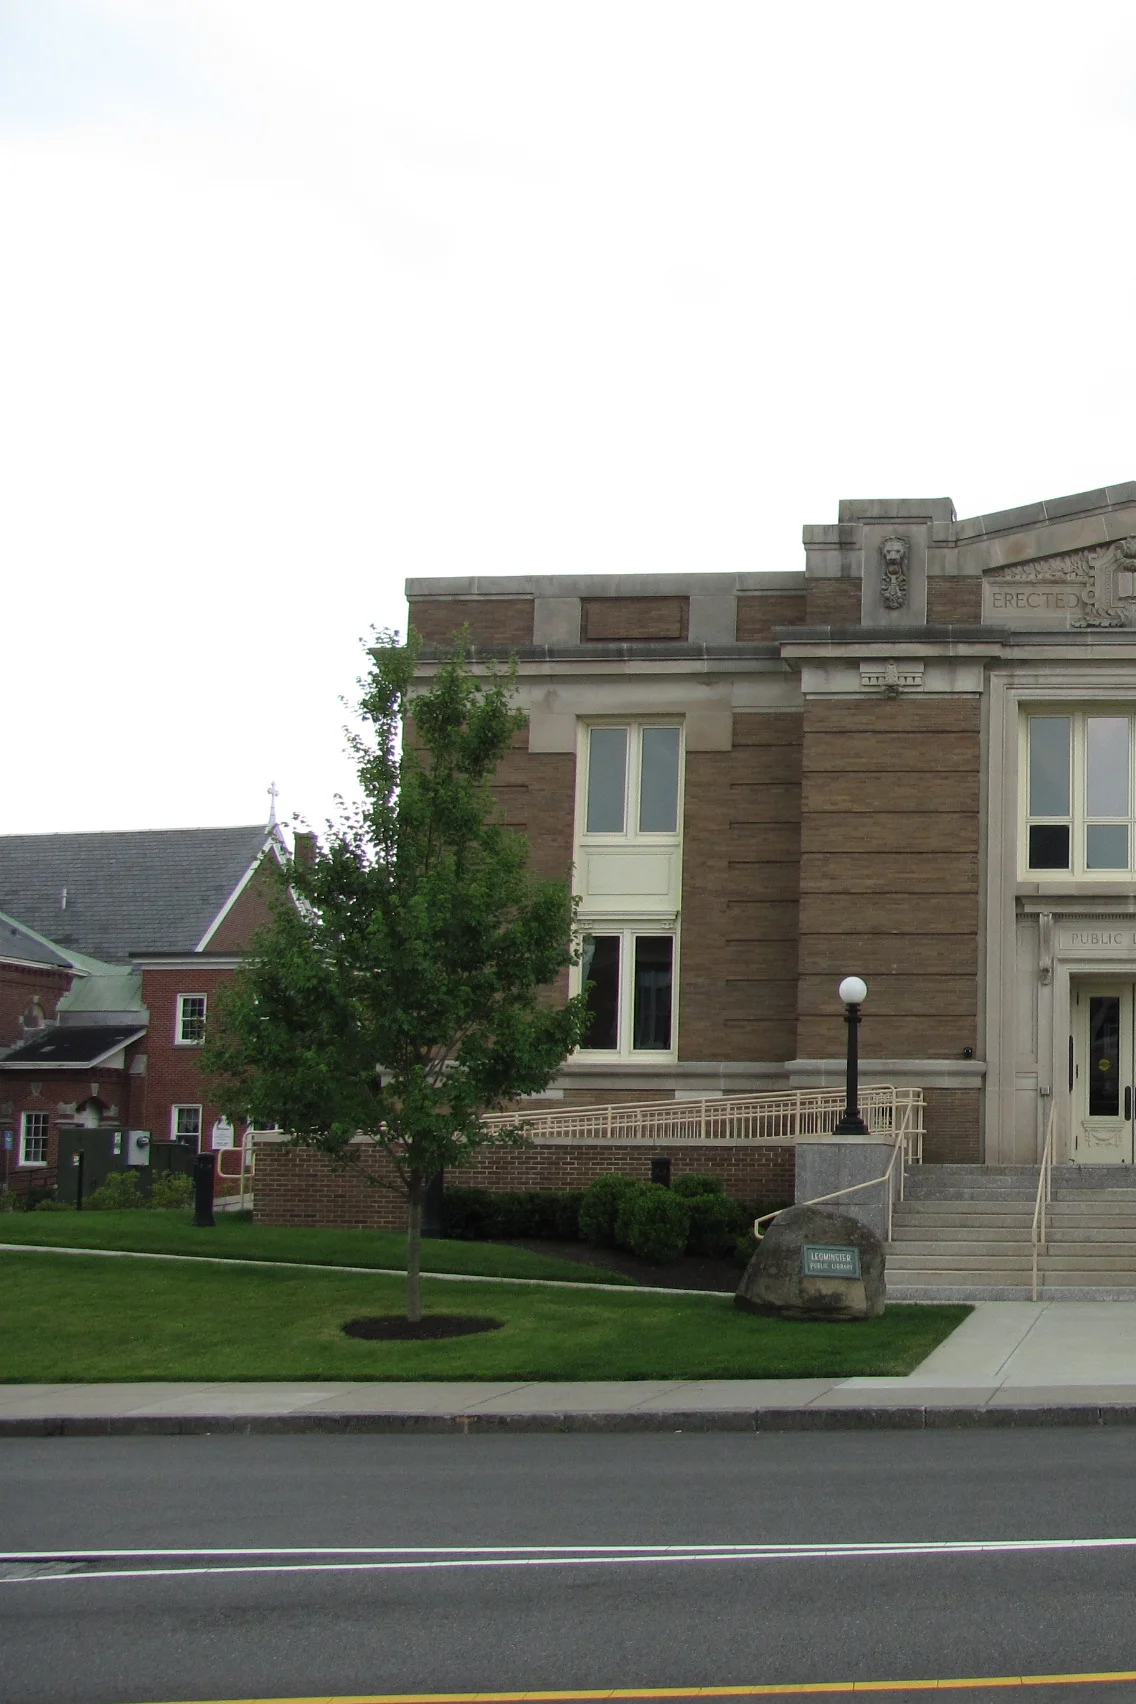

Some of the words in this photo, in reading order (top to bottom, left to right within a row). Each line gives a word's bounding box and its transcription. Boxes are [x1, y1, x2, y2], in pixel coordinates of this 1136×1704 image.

[992, 592, 1080, 609] ERECTED
[1071, 933, 1123, 945] PUBLIC
[811, 1252, 851, 1262] LEOMINSTER
[831, 1263, 853, 1271] LIBRARY
